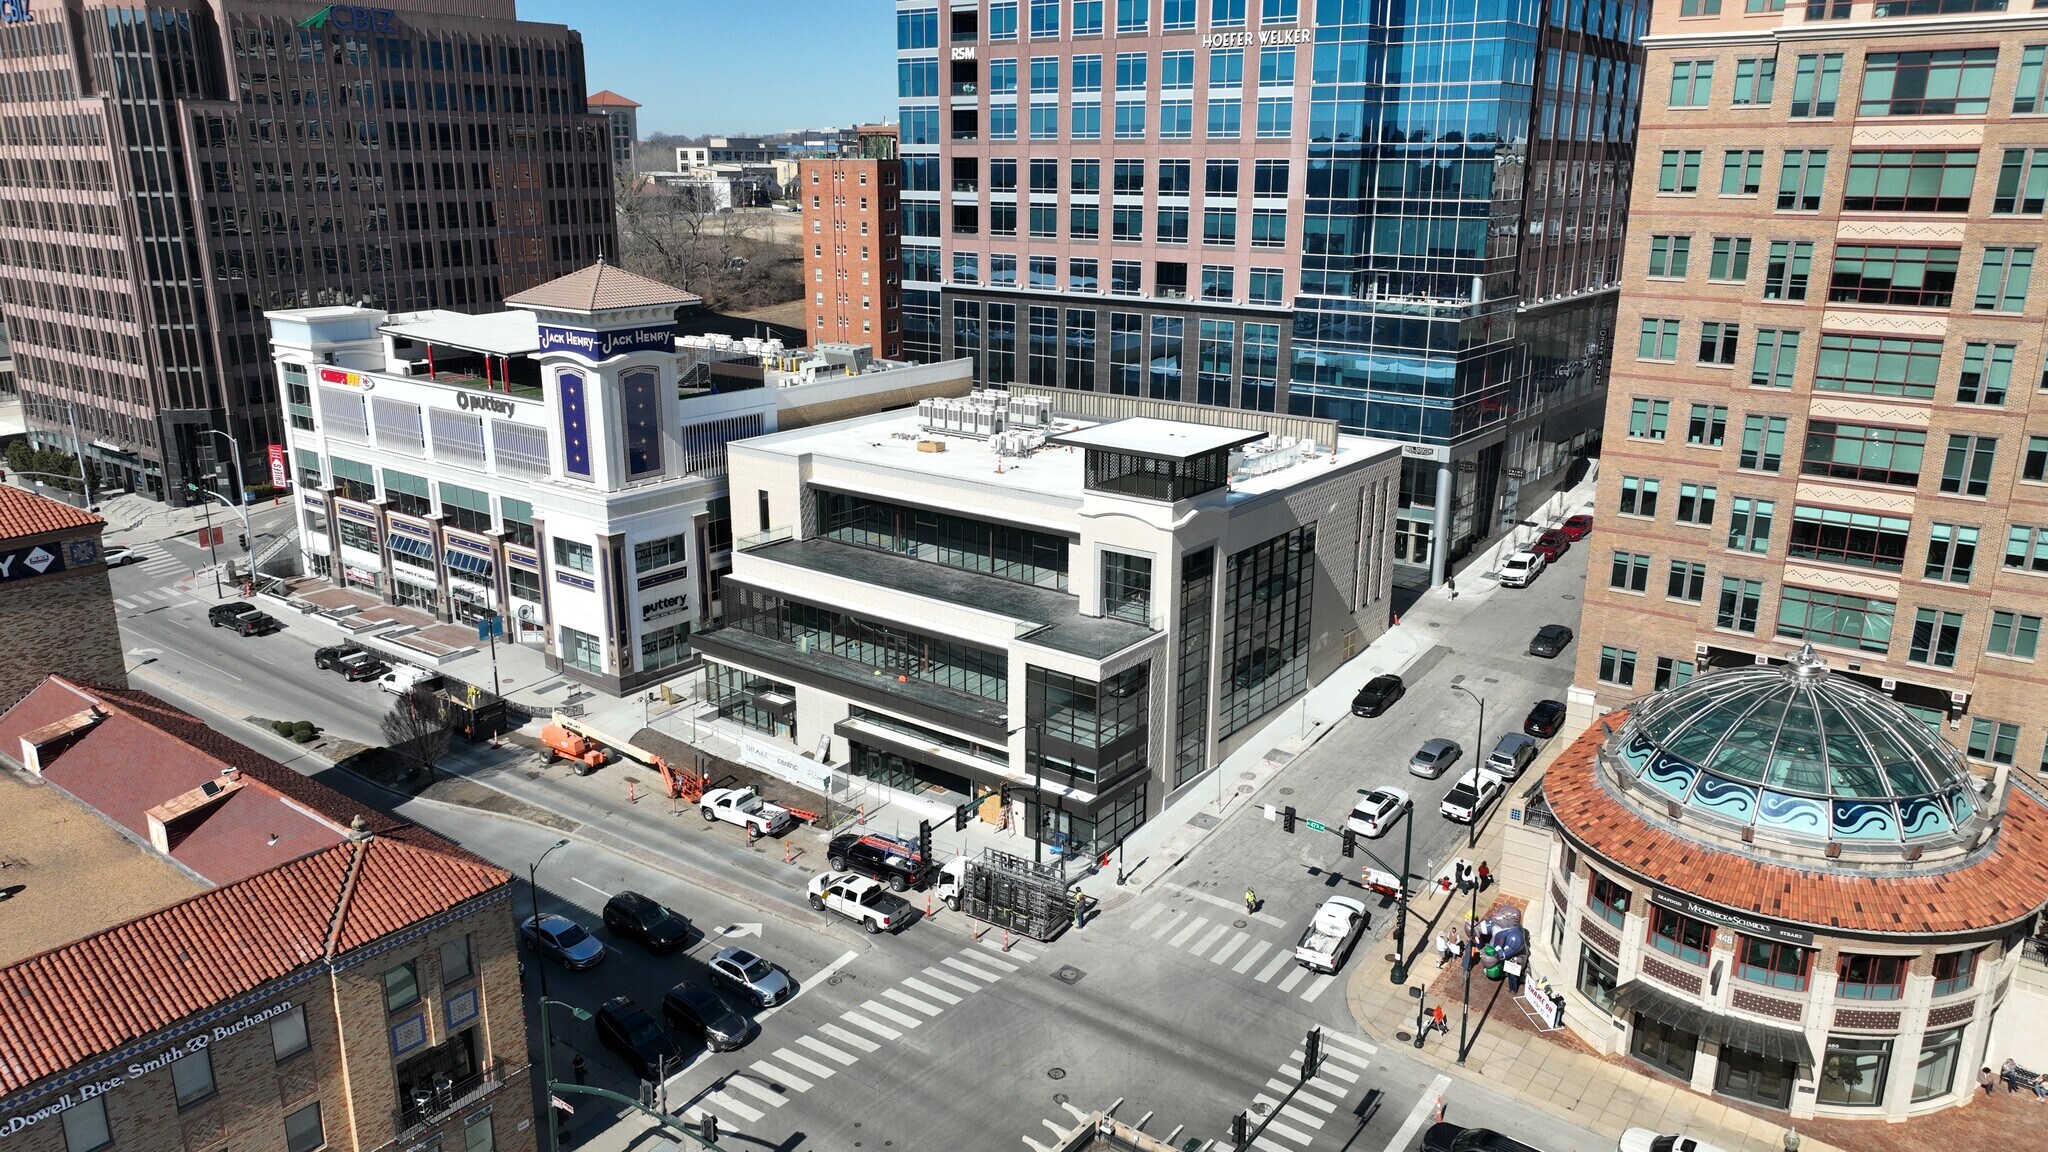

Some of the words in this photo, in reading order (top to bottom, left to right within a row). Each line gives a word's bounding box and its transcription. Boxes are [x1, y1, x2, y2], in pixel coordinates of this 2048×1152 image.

[331, 5, 397, 33] CBIZ
[1202, 31, 1254, 48] HOEFER
[1258, 29, 1311, 46] WELKER
[951, 47, 975, 60] RSM
[470, 393, 516, 418] puttery
[1404, 445, 1434, 455] BLOCK
[273, 463, 286, 486] CHIEFS
[643, 594, 687, 617] puttery
[746, 744, 768, 758] DRAKE
[777, 758, 798, 770] centric
[1658, 894, 1683, 906] SEAFOOD
[1779, 930, 1803, 939] STEAKS
[1716, 933, 1733, 945] 448
[1528, 985, 1546, 1008] SHAME
[1546, 1003, 1553, 1014] ON
[79, 1077, 125, 1102] Rice,
[128, 1046, 183, 1079] Smith
[187, 1034, 209, 1051] &
[213, 1001, 292, 1042] Buchanan
